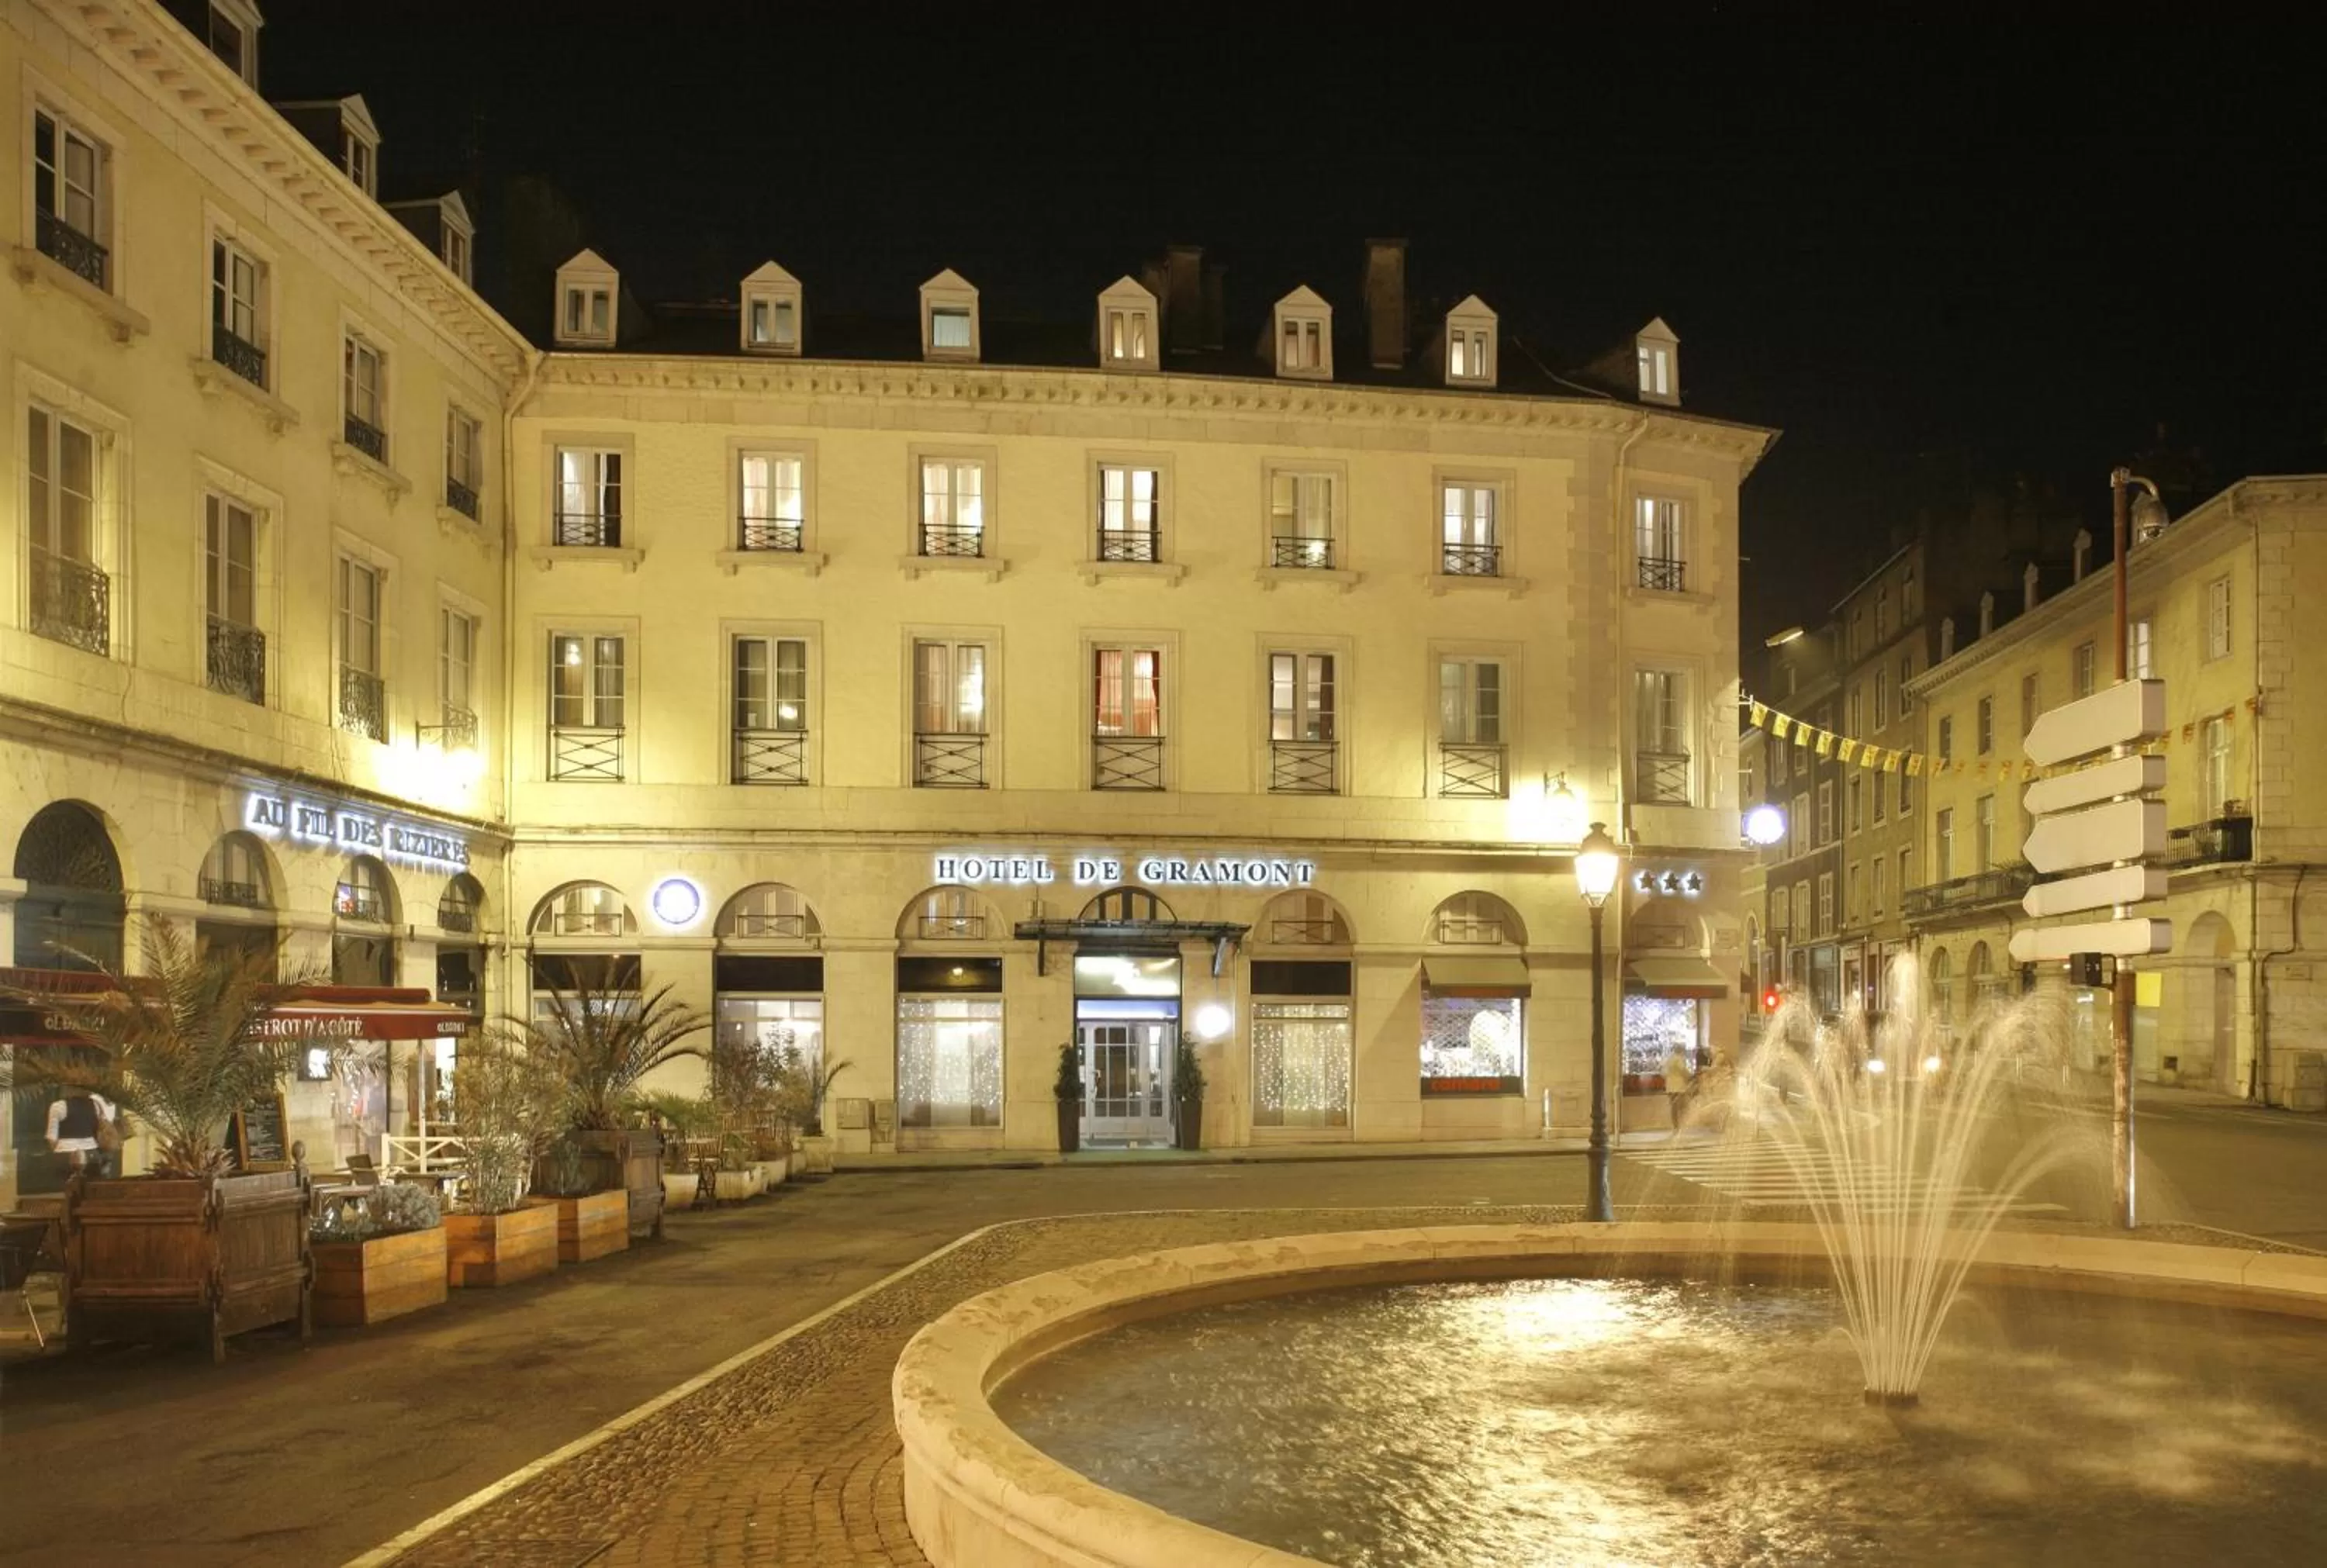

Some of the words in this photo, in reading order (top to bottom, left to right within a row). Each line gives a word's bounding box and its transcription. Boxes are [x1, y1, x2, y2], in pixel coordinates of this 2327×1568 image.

[252, 797, 286, 827] AU
[297, 806, 337, 839] FIL
[341, 815, 381, 848] DES
[937, 858, 1053, 880] HOTEL
[1075, 860, 1119, 881] DE
[1143, 861, 1316, 882] GRAMONT
